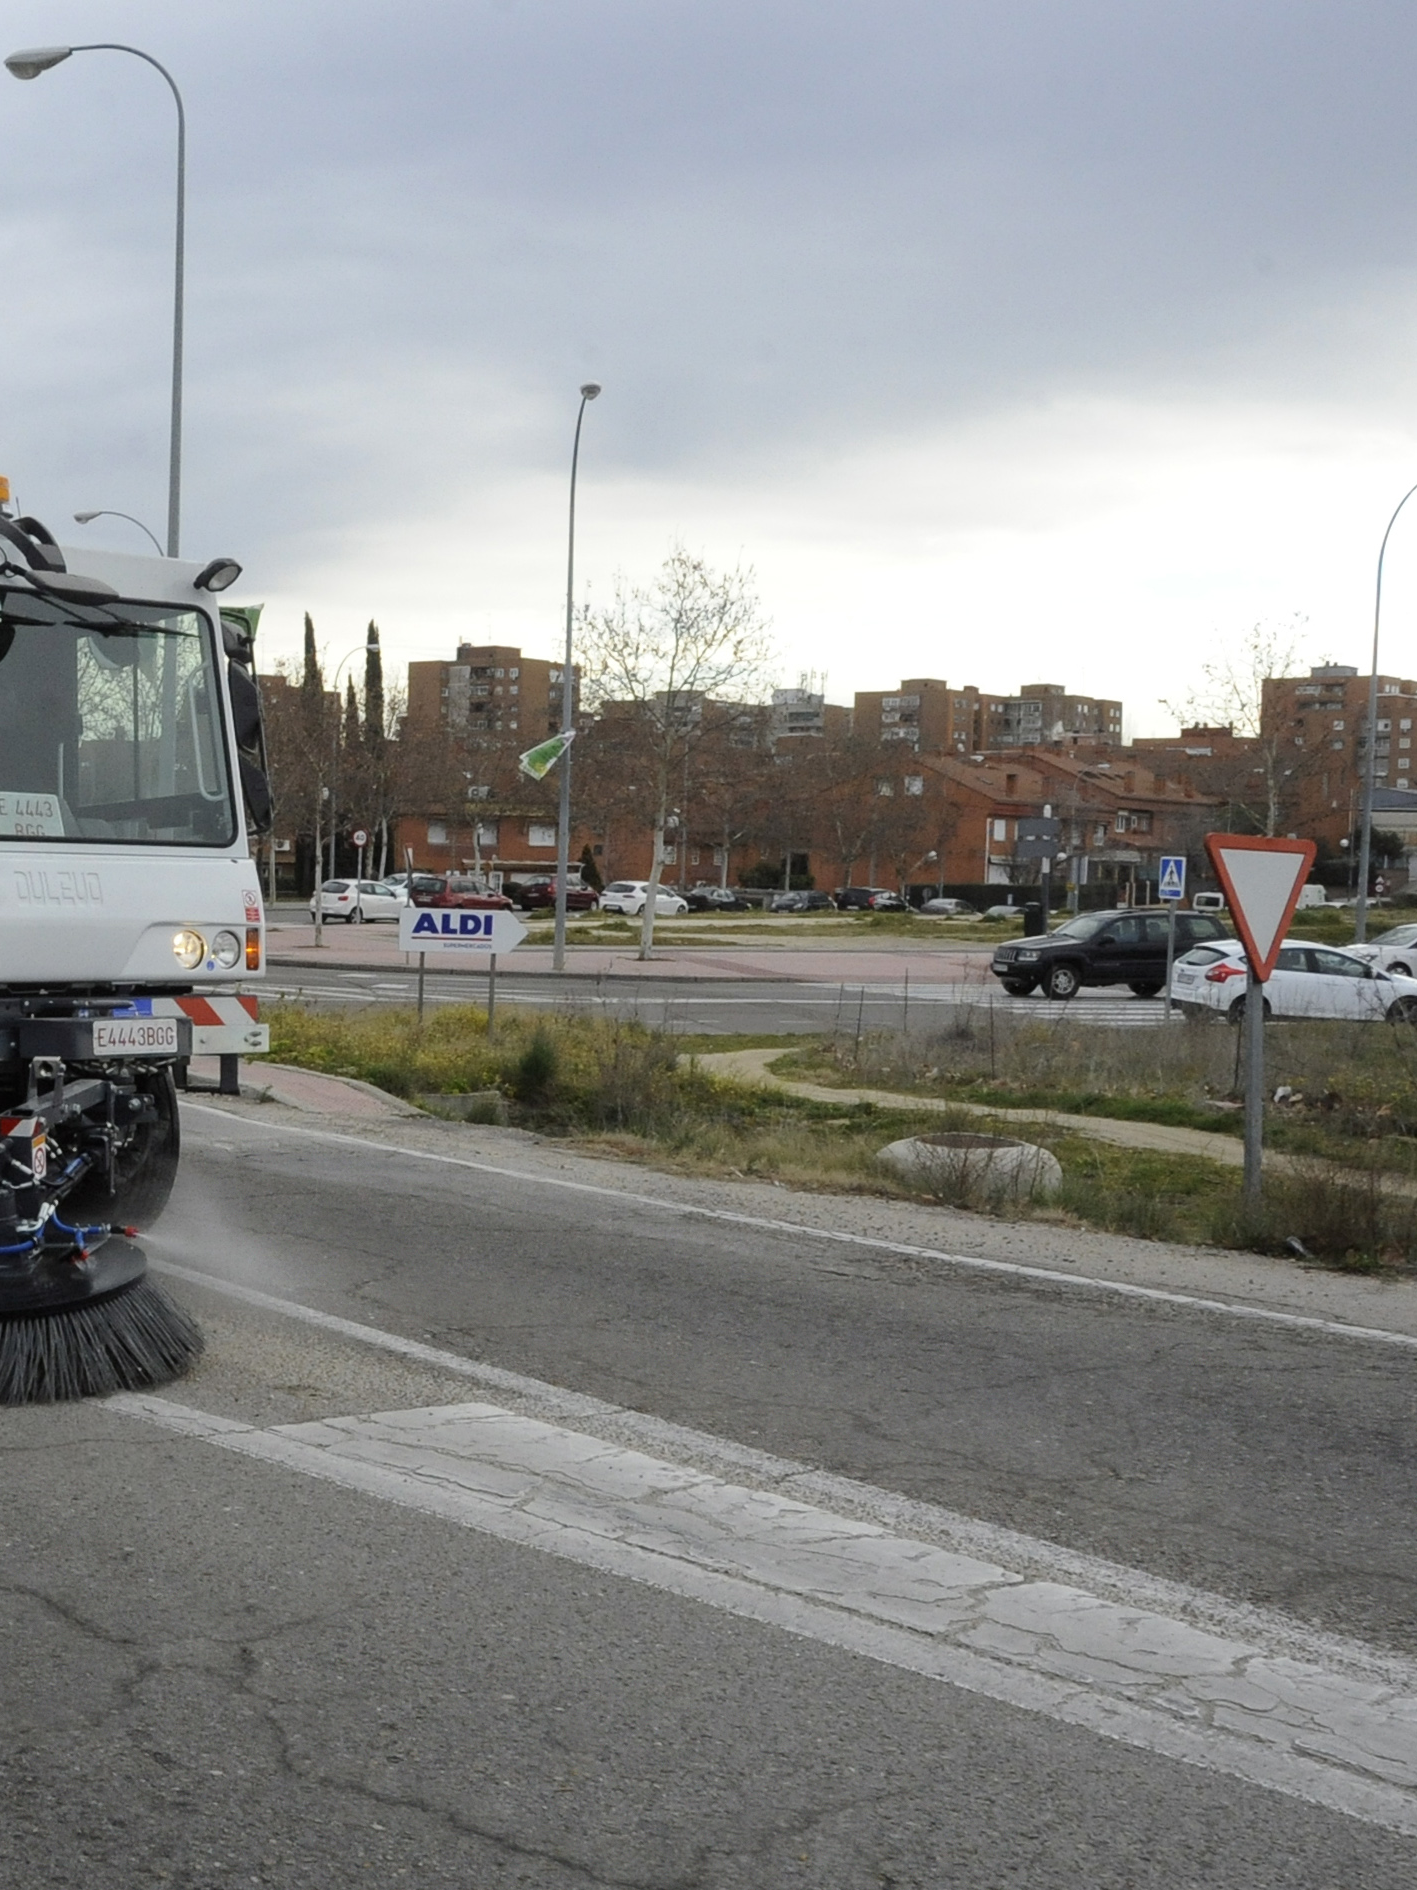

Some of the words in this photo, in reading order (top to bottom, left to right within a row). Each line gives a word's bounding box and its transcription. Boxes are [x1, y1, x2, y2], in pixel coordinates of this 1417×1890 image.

[15, 800, 54, 818] 4443
[412, 912, 493, 935] ALDI
[97, 1027, 174, 1047] E4443BGG
